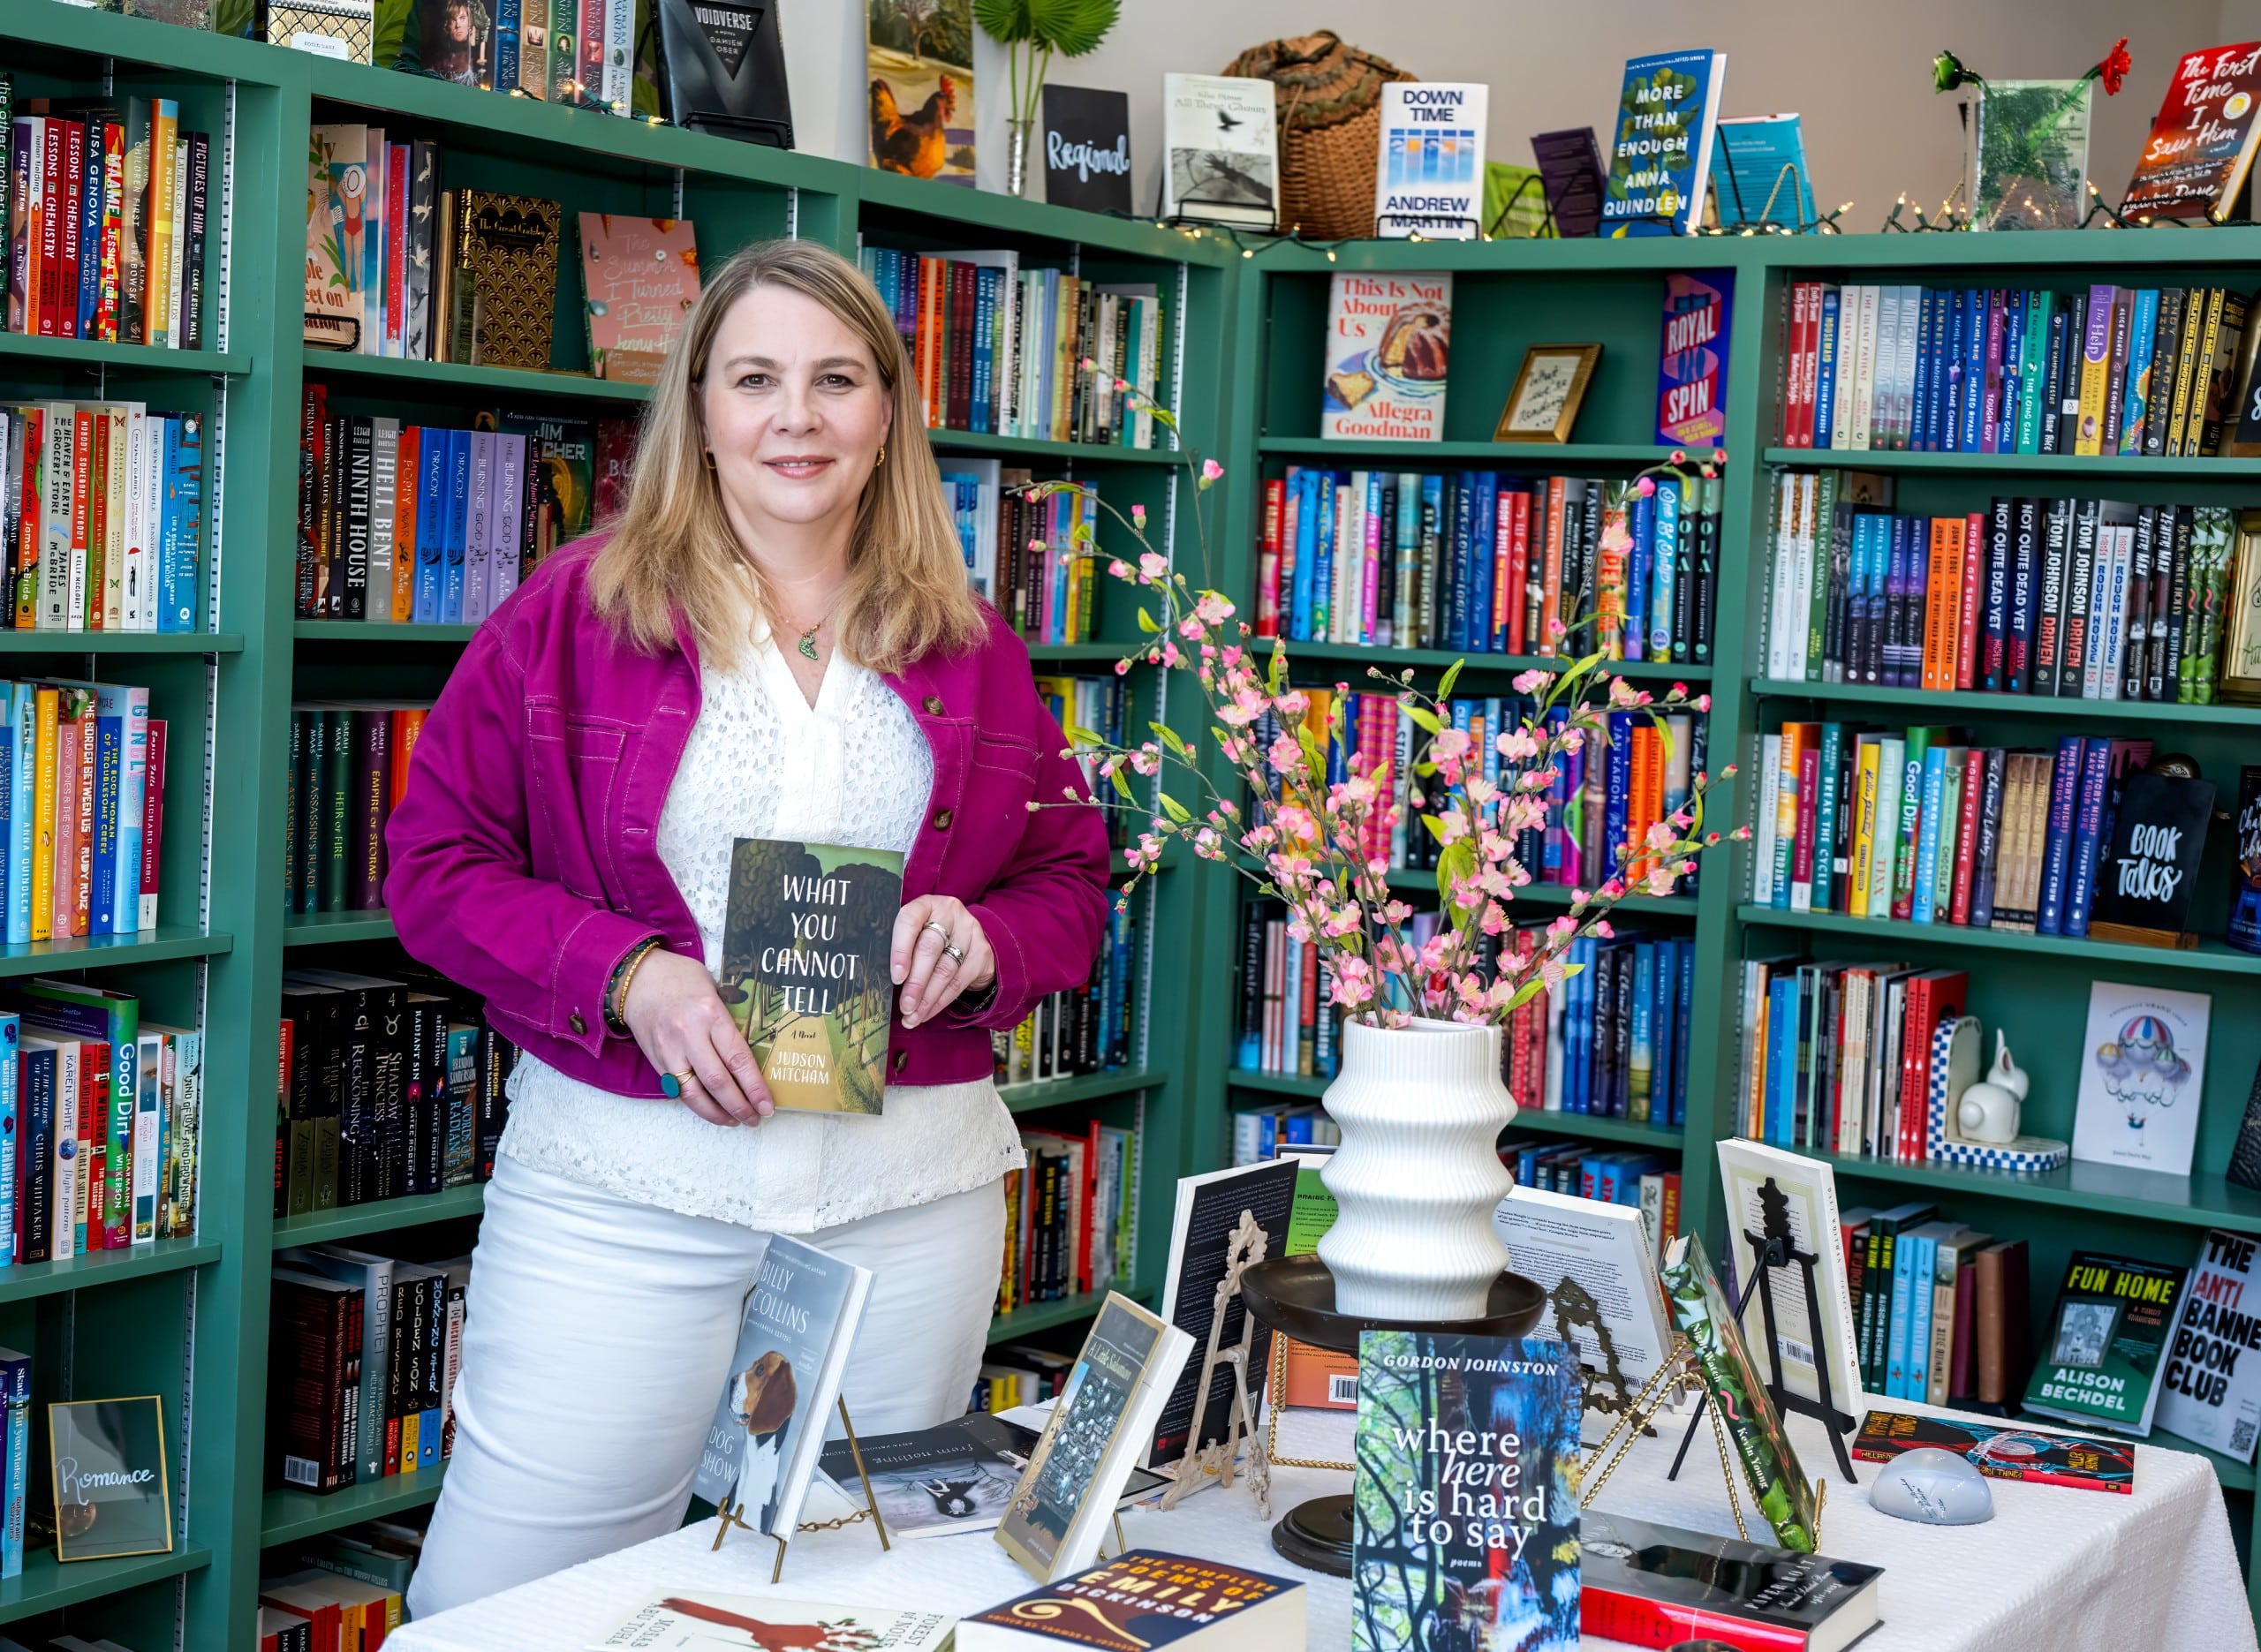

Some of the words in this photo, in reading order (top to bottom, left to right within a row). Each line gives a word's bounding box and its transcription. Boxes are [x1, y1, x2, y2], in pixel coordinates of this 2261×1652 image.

[694, 6, 752, 31] VOIDVERSE
[709, 36, 743, 47] DAMIEN
[715, 46, 738, 55] OBER
[2181, 56, 2210, 80] The
[2212, 45, 2261, 79] First
[1403, 89, 1463, 106] DOWN
[1636, 85, 1684, 104] MORE
[2183, 79, 2235, 107] Time
[1410, 107, 1455, 123] TIME
[1635, 111, 1678, 131] THAN
[2188, 105, 2209, 131] I
[48, 127, 58, 177] LESSONS
[90, 125, 101, 158] LISA
[1047, 130, 1130, 183] Regional
[1617, 136, 1689, 159] ENOUGH
[2144, 137, 2192, 161] Saw
[2196, 118, 2237, 147] Him
[105, 153, 122, 215] MAAME
[196, 141, 208, 192] PICTURES
[1623, 170, 1670, 189] ANNA
[87, 164, 99, 228] GENOVA
[164, 168, 173, 212] NORTH
[194, 197, 204, 215] OF
[1385, 196, 1470, 212] ANDREW
[1603, 195, 1688, 217] QUINDLEN
[44, 196, 57, 259] CHEMISTRY
[193, 219, 203, 235] HIM
[479, 217, 492, 231] The
[495, 220, 517, 234] Great
[518, 222, 547, 239] Gatsby
[1389, 213, 1464, 229] MARTIN
[106, 228, 117, 268] JESSICA
[622, 236, 650, 252] The
[603, 258, 677, 279] Summer
[104, 268, 115, 312] GEORGE
[304, 284, 324, 306] eet
[326, 290, 344, 307] on
[621, 283, 684, 299] Turned
[1340, 277, 1385, 297] This
[1388, 280, 1405, 298] Is
[1410, 283, 1443, 301] Not
[617, 306, 675, 326] Pretty
[1340, 298, 1398, 317] About
[1338, 318, 1366, 337] Us
[1667, 306, 1717, 354] ROYAL
[2086, 324, 2104, 354] Help
[1366, 401, 1433, 423] Allegra
[1667, 381, 1711, 423] SPIN
[1335, 418, 1431, 439] Goodman
[350, 449, 369, 517] NINTH
[375, 456, 395, 509] HELL
[1584, 488, 1598, 539] FAMILY
[1996, 503, 2008, 530] NOT
[373, 517, 392, 571] BENT
[1993, 532, 2007, 568] QUITE
[2049, 517, 2064, 549] TOM
[58, 550, 67, 588] JAMES
[348, 520, 367, 588] HOUSE
[1546, 511, 1559, 596] Correspondent
[1815, 537, 1827, 600] OCCASIONS
[1990, 571, 2004, 605] DEAD
[2043, 553, 2060, 614] JOHNSON
[1988, 607, 2001, 630] YET
[2039, 617, 2056, 666] DRIVEN
[86, 700, 95, 719] THE
[84, 721, 95, 766] BORDER
[82, 767, 94, 819] BETWEEN
[371, 770, 381, 813] EMPIRE
[1822, 777, 1834, 815] BREAK
[81, 820, 91, 834] US
[1821, 821, 1831, 842] THE
[2130, 824, 2182, 863] BOOK
[80, 847, 91, 876] RUDY
[368, 834, 377, 882] STORMS
[1818, 849, 1828, 886] CYCLE
[1938, 846, 1950, 894] CHOCOLAT
[79, 878, 89, 910] RUIZ
[783, 874, 851, 906] WHAT
[2117, 859, 2182, 903] Talks
[791, 912, 836, 941] YOU
[761, 947, 860, 980] CANNOT
[781, 984, 833, 1015] TELL
[791, 1030, 798, 1039] A
[119, 1043, 134, 1098] Good
[769, 1068, 829, 1084] MITCHAM
[777, 1051, 826, 1068] JUDSON
[350, 1045, 365, 1135] RECKONING
[375, 1054, 389, 1122] PRINCESS
[386, 1052, 403, 1120] SHADOW
[117, 1101, 133, 1136] Dirt
[114, 1154, 123, 1209] WILKERSON
[32, 1176, 42, 1241] WHITAKER
[2208, 1231, 2256, 1274] THE
[760, 1258, 794, 1293] BILLY
[2068, 1265, 2110, 1293] FUN
[2114, 1271, 2175, 1304] HOME
[2192, 1271, 2245, 1309] ANTI
[374, 1274, 389, 1355] PROPHET
[411, 1283, 425, 1352] GOLDEN
[431, 1279, 442, 1347] MORNING
[752, 1288, 811, 1335] COLLINS
[2183, 1298, 2261, 1352] BANNE
[1384, 1354, 1460, 1369] GORDON
[1464, 1359, 1559, 1377] JOHNSTON
[1691, 1324, 1710, 1355] Night
[1704, 1348, 1722, 1384] Watch
[2174, 1327, 2241, 1377] BOOK
[409, 1357, 419, 1392] SON
[428, 1352, 438, 1392] STAR
[2053, 1369, 2125, 1392] ALISON
[2165, 1360, 2228, 1407] CLUB
[2041, 1383, 2126, 1411] BECHDEL
[708, 1425, 735, 1455] DOG
[936, 1444, 975, 1456] from
[1392, 1417, 1520, 1457] where
[700, 1449, 738, 1482] SHOW
[872, 1451, 932, 1465] nothing
[1441, 1448, 1521, 1488] here
[1737, 1426, 1756, 1457] Kevin
[1748, 1452, 1769, 1490] Young
[56, 1456, 155, 1506] Romance
[1404, 1481, 1436, 1515] is
[1450, 1480, 1546, 1522] hard
[1412, 1513, 1453, 1545] to
[1466, 1521, 1532, 1561] say
[1130, 1556, 1168, 1567] THE
[1170, 1563, 1278, 1592] COMPLETE
[1450, 1558, 1482, 1568] poems
[1078, 1571, 1244, 1613] EMILY
[1108, 1562, 1216, 1588] POEMS
[1221, 1586, 1265, 1601] OF
[1743, 1583, 1788, 1610] PAPER
[1055, 1582, 1216, 1624] DICKINSON
[904, 1613, 943, 1646] FOREST
